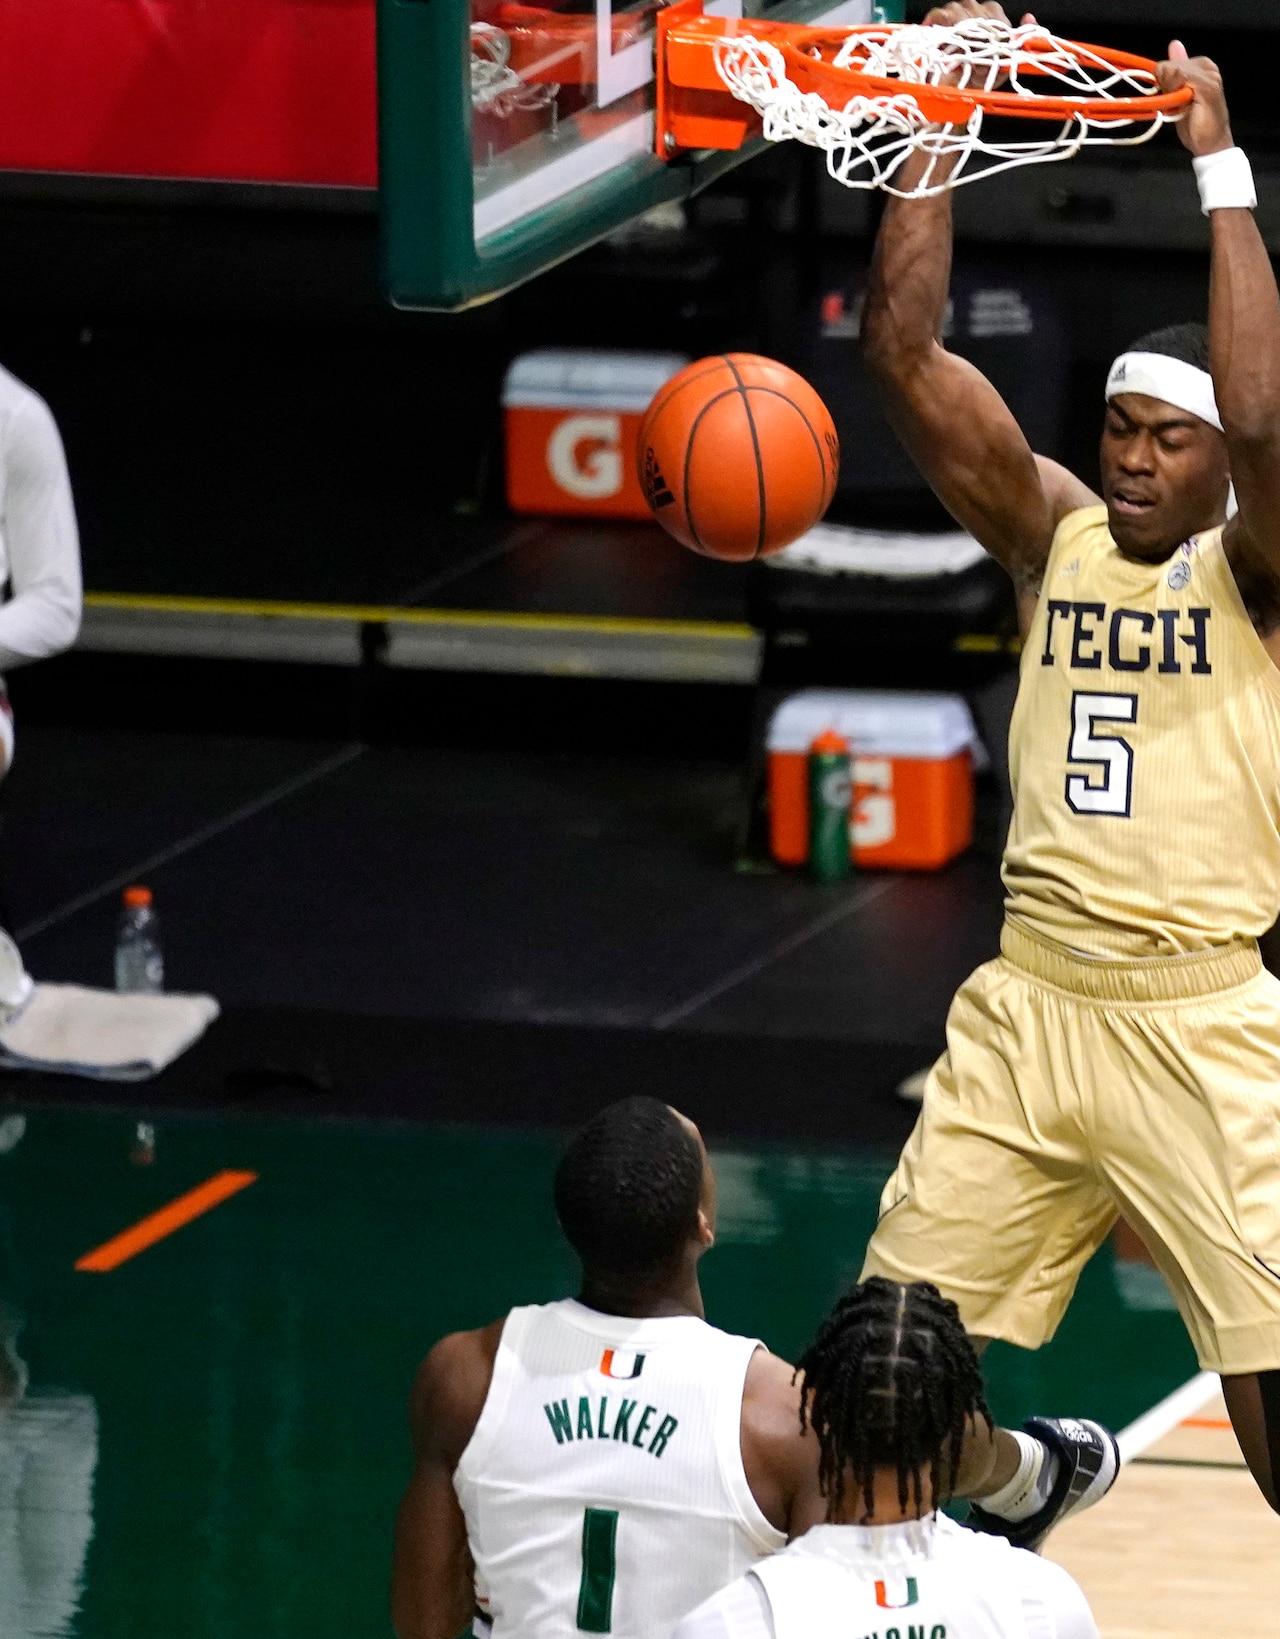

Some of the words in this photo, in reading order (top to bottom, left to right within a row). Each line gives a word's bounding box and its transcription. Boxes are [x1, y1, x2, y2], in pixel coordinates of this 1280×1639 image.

[546, 413, 622, 499] G
[1040, 598, 1212, 675] TECH
[1064, 689, 1138, 818] 5
[600, 1349, 646, 1380] U
[543, 1396, 677, 1458] WALKER
[576, 1506, 619, 1633] 1
[874, 1577, 919, 1609] U
